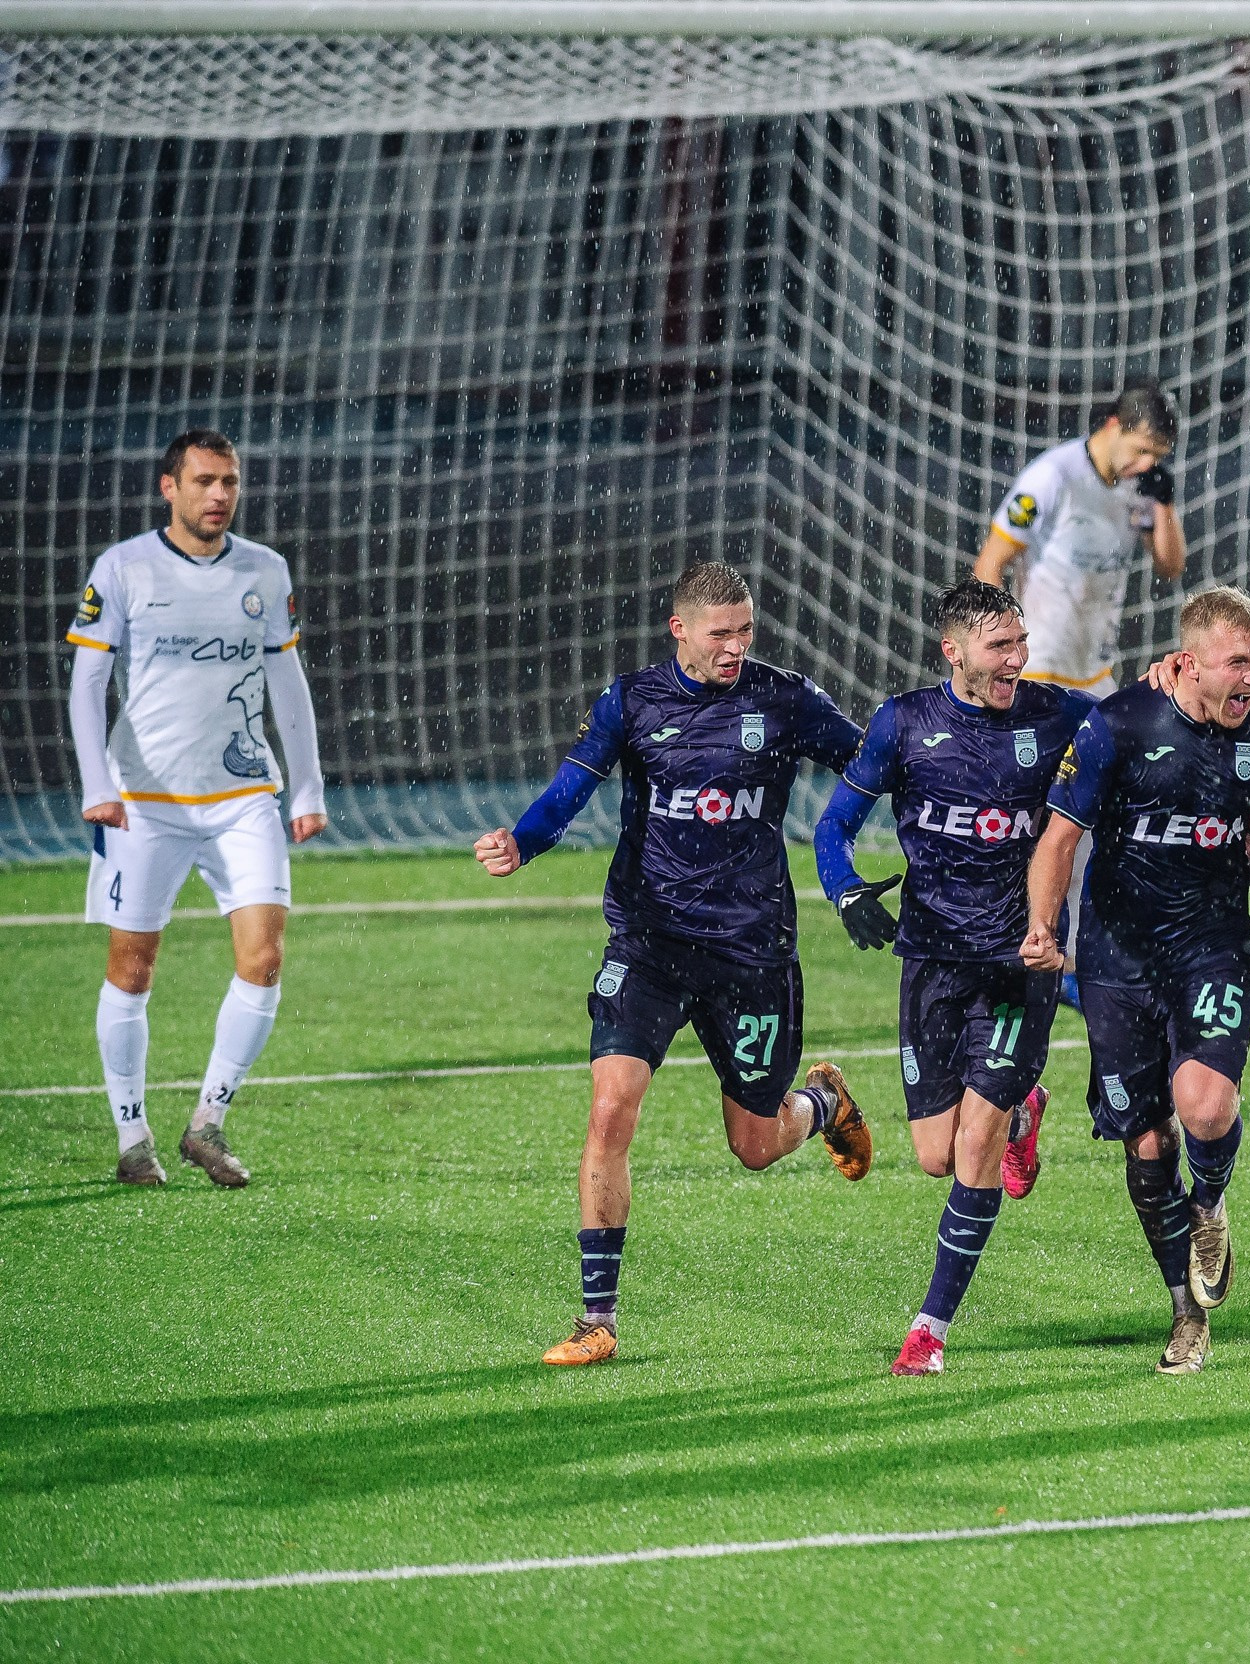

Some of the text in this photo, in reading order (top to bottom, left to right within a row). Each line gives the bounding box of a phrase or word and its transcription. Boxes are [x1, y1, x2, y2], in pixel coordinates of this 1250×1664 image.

[649, 784, 764, 824] LEON
[109, 871, 122, 911] 4
[988, 1002, 1025, 1056] 11
[1192, 983, 1242, 1029] 45
[734, 1015, 779, 1066] 27
